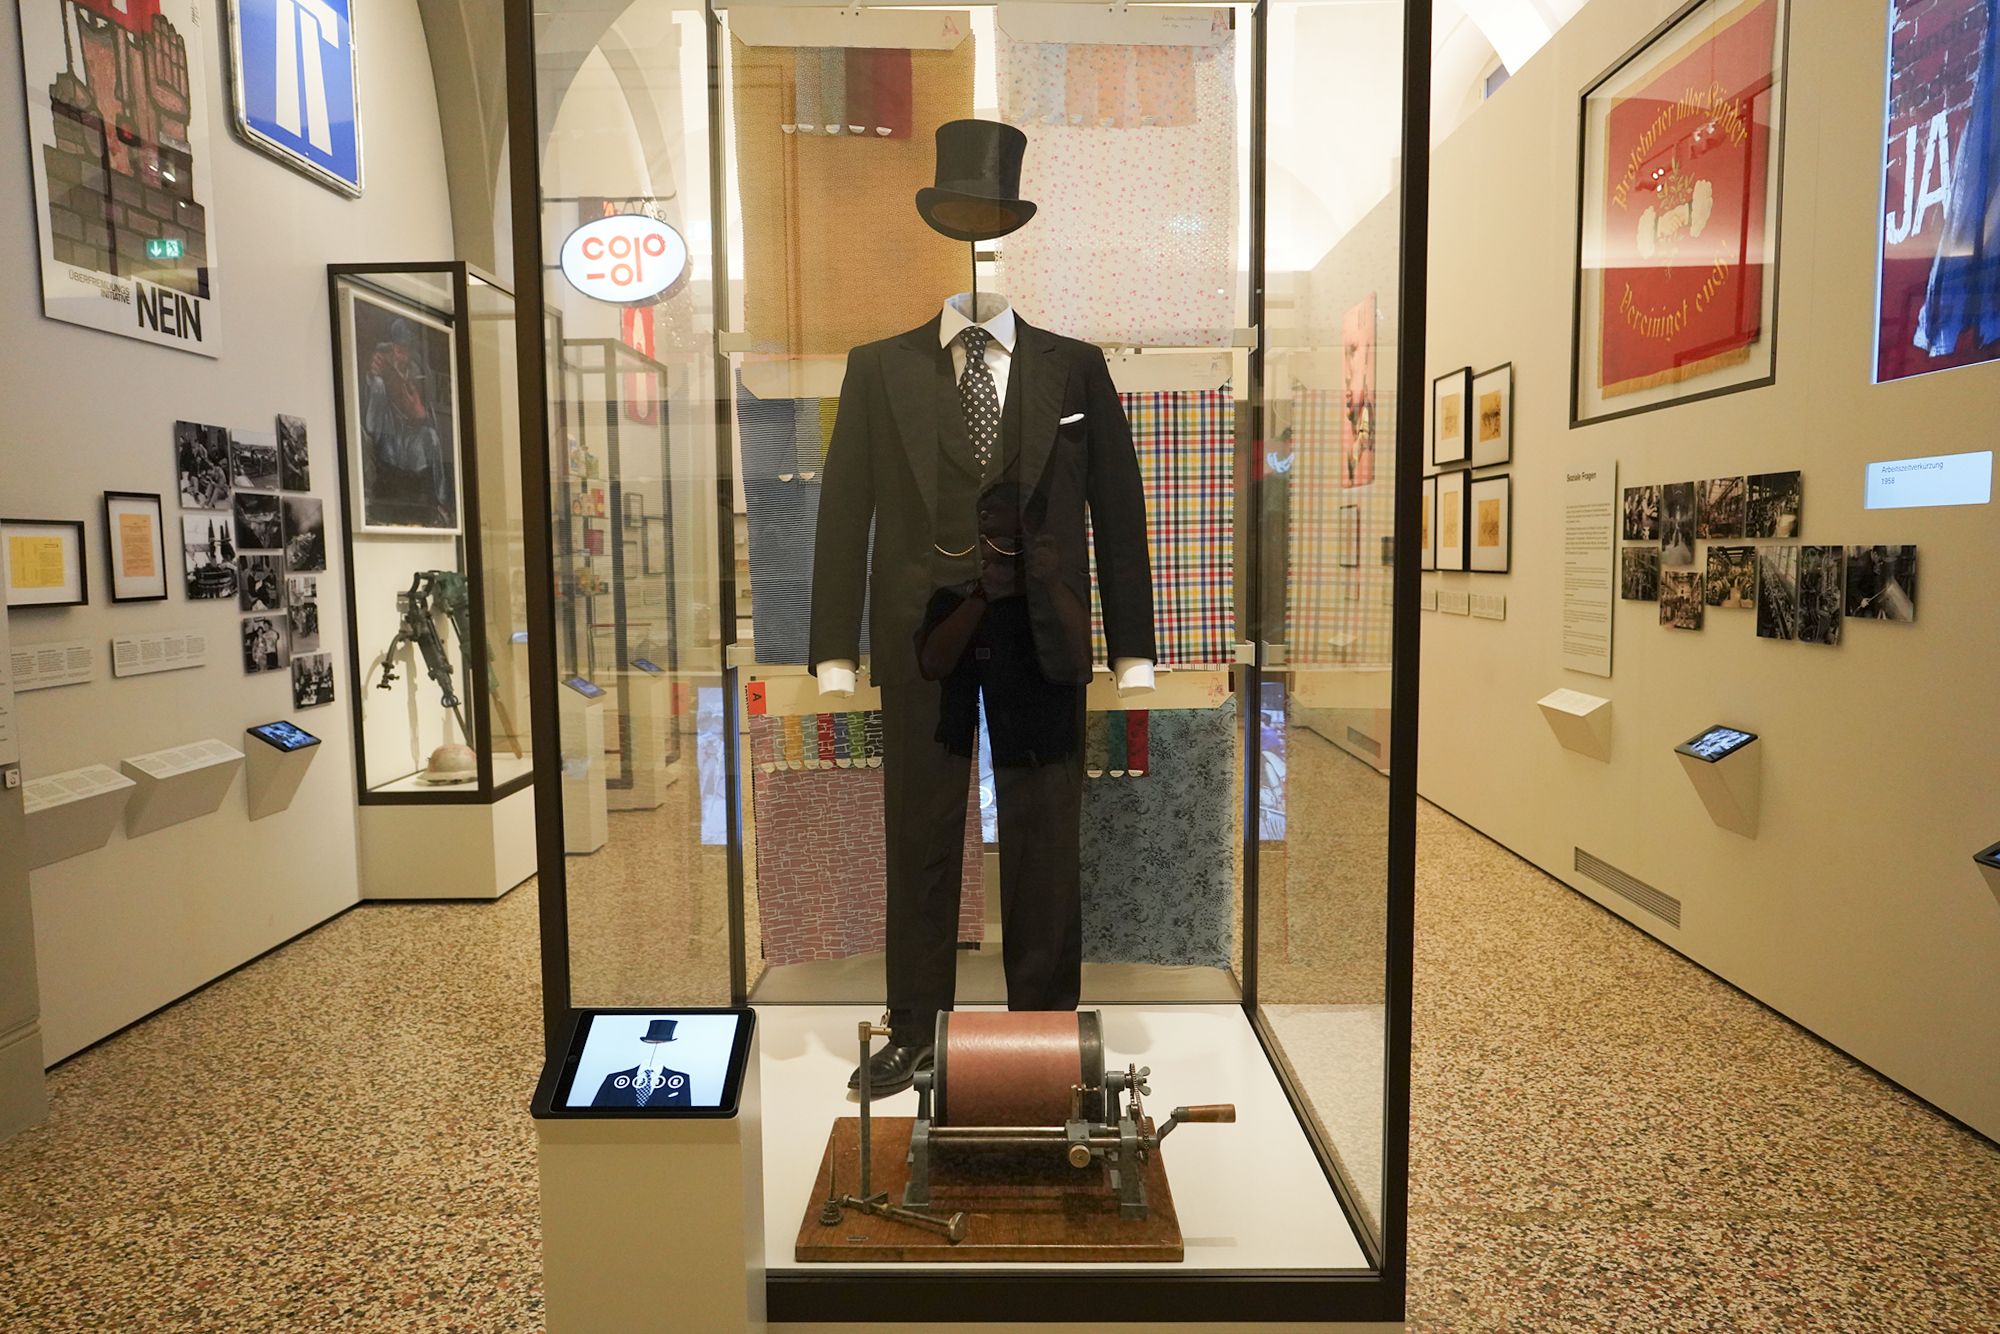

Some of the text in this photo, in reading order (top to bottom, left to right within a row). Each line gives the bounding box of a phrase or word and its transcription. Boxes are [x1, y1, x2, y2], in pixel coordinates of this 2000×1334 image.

[1886, 110, 1951, 244] JA
[101, 288, 131, 304] INITIATIVE
[135, 281, 203, 342] NEIN
[1881, 462, 1944, 474] Arbeitszeitverkürzung
[1582, 471, 1597, 481] Fragen
[1881, 477, 1896, 485] 1958
[752, 692, 762, 702] A
